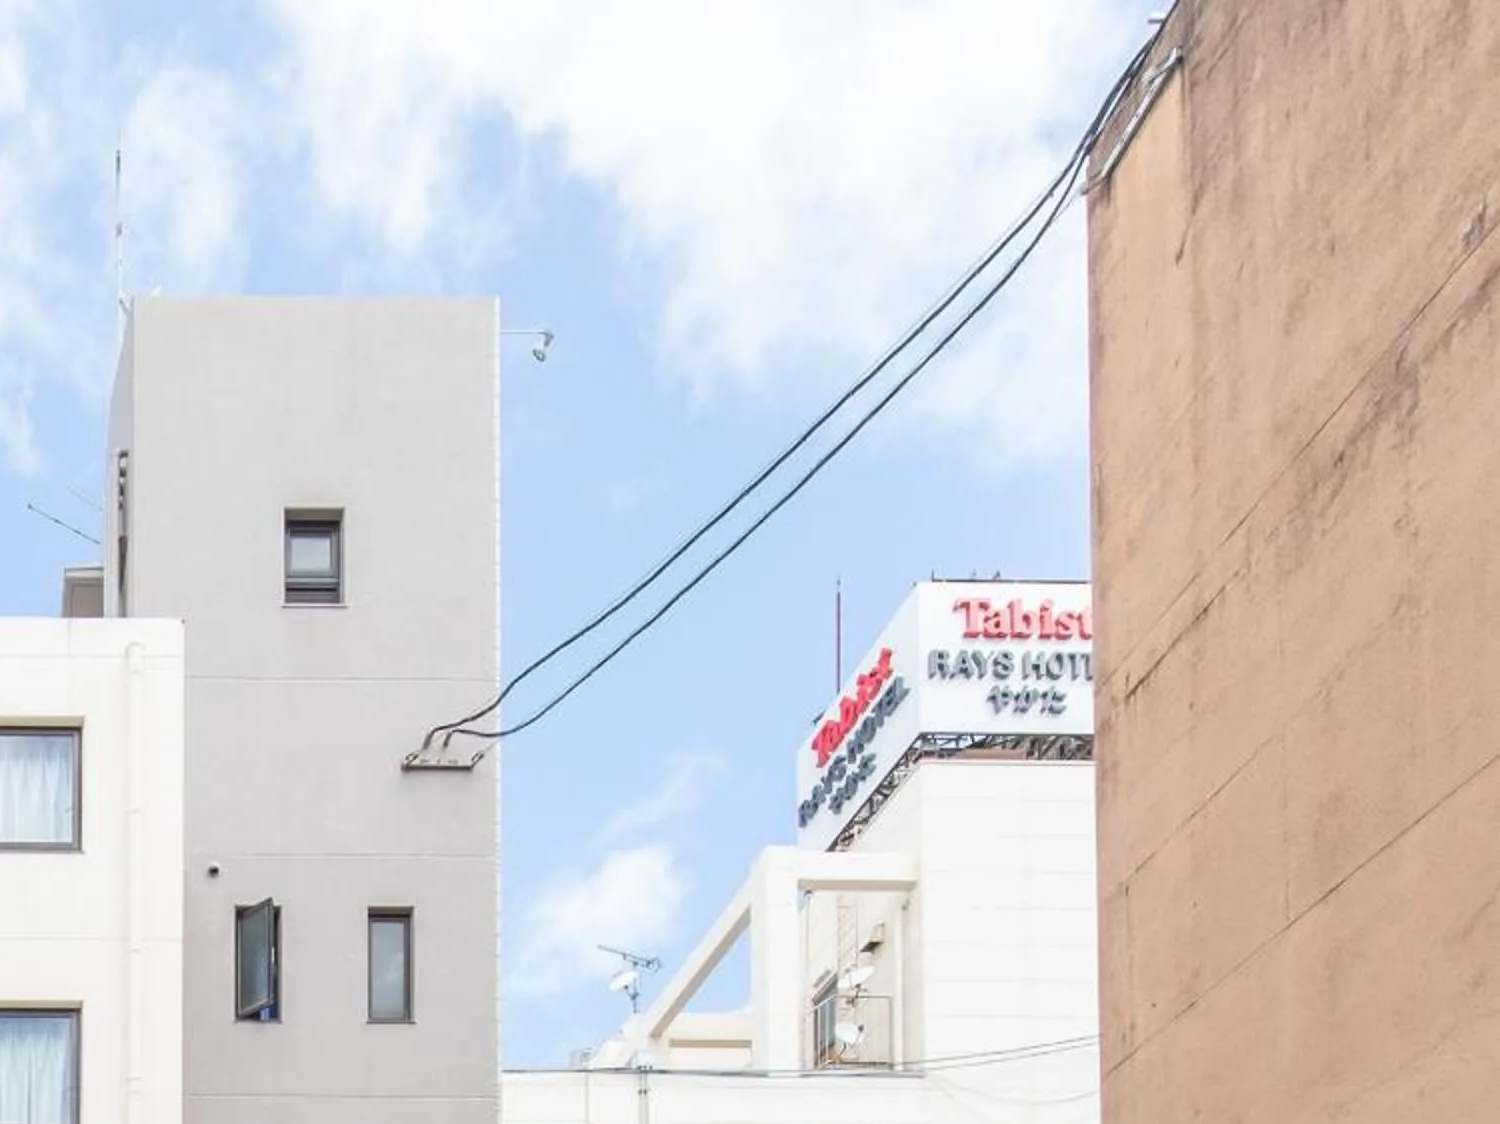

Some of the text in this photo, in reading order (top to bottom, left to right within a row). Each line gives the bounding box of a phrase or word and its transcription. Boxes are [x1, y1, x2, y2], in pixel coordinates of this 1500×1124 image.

[953, 599, 1093, 639] Tabist
[927, 650, 1015, 680] RAYS
[811, 647, 893, 768] Tabist
